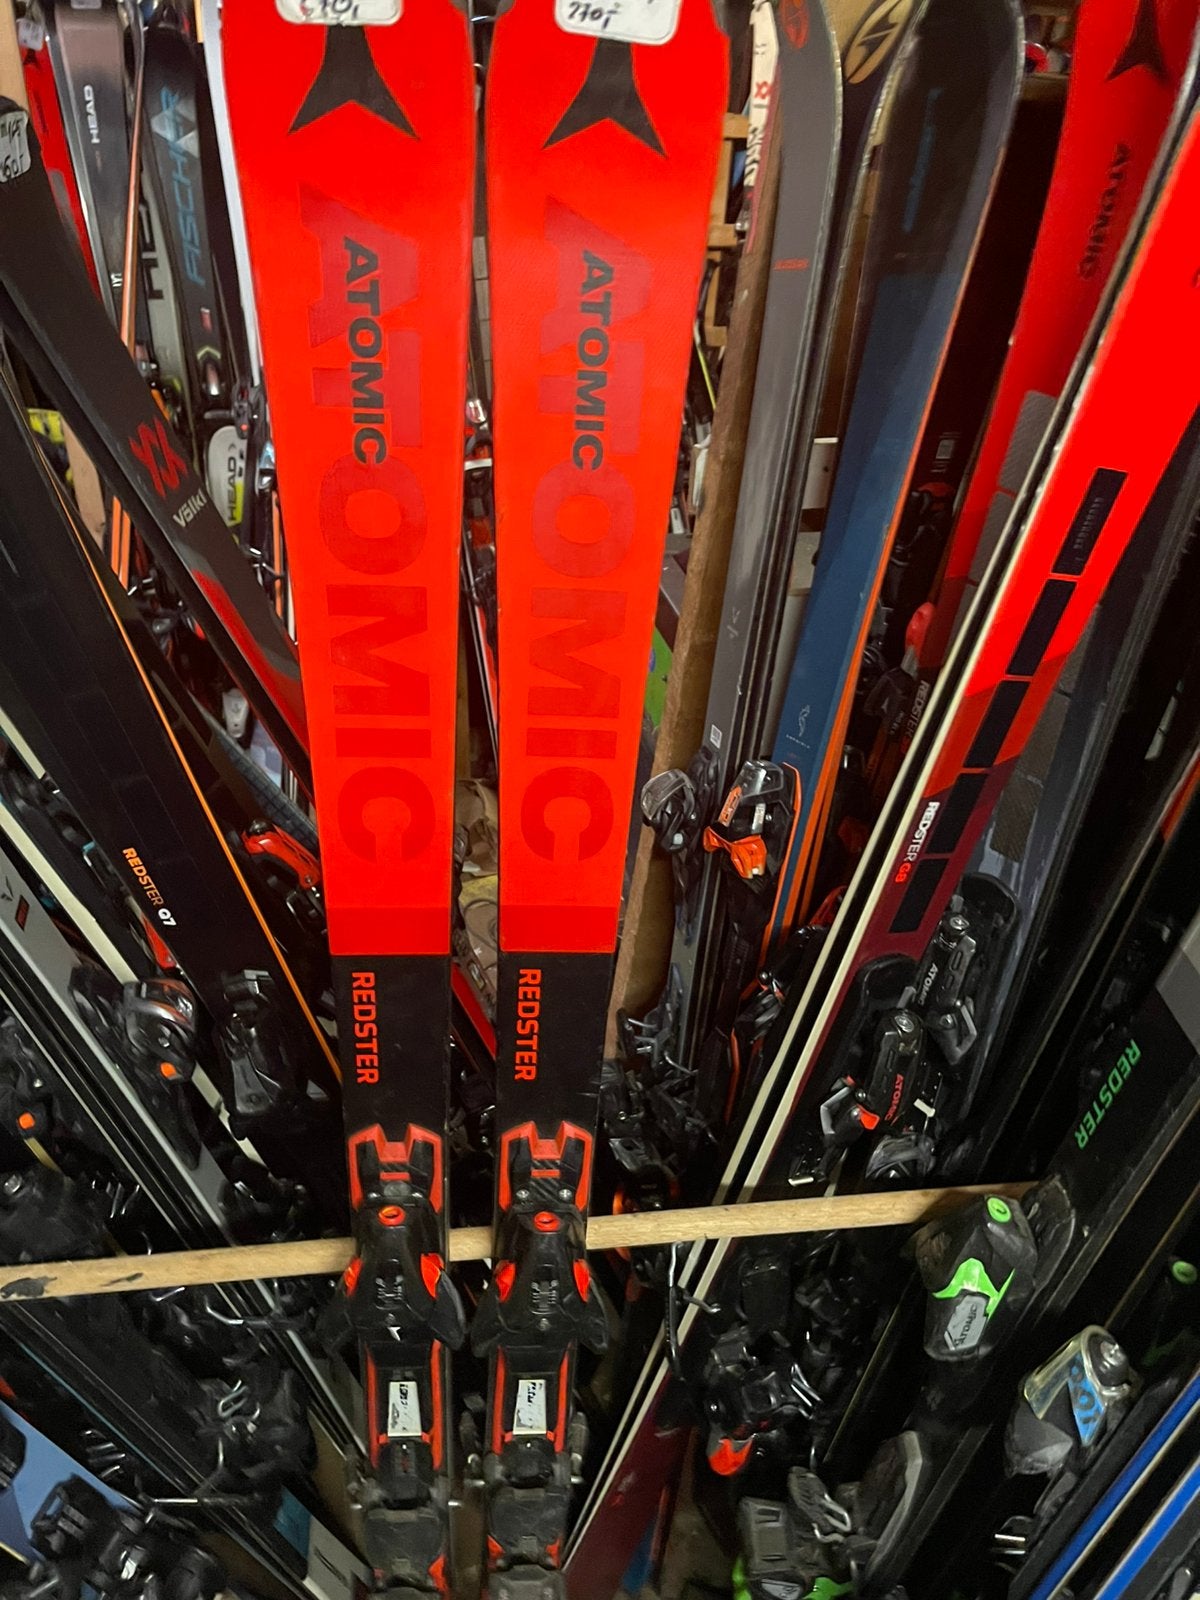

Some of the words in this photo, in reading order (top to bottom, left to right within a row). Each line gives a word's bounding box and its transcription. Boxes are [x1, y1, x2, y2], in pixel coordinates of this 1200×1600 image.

[83, 85, 101, 145] HEAD
[343, 234, 388, 465] ATOMIC
[571, 249, 615, 471] ATOMIC
[122, 847, 165, 907] REDSTER
[906, 801, 941, 862] REDSTER
[351, 971, 380, 1085] REDSTER
[513, 968, 542, 1083] REDSTER
[885, 1074, 905, 1122] ATOMIC
[1074, 1038, 1142, 1150] REDSTER
